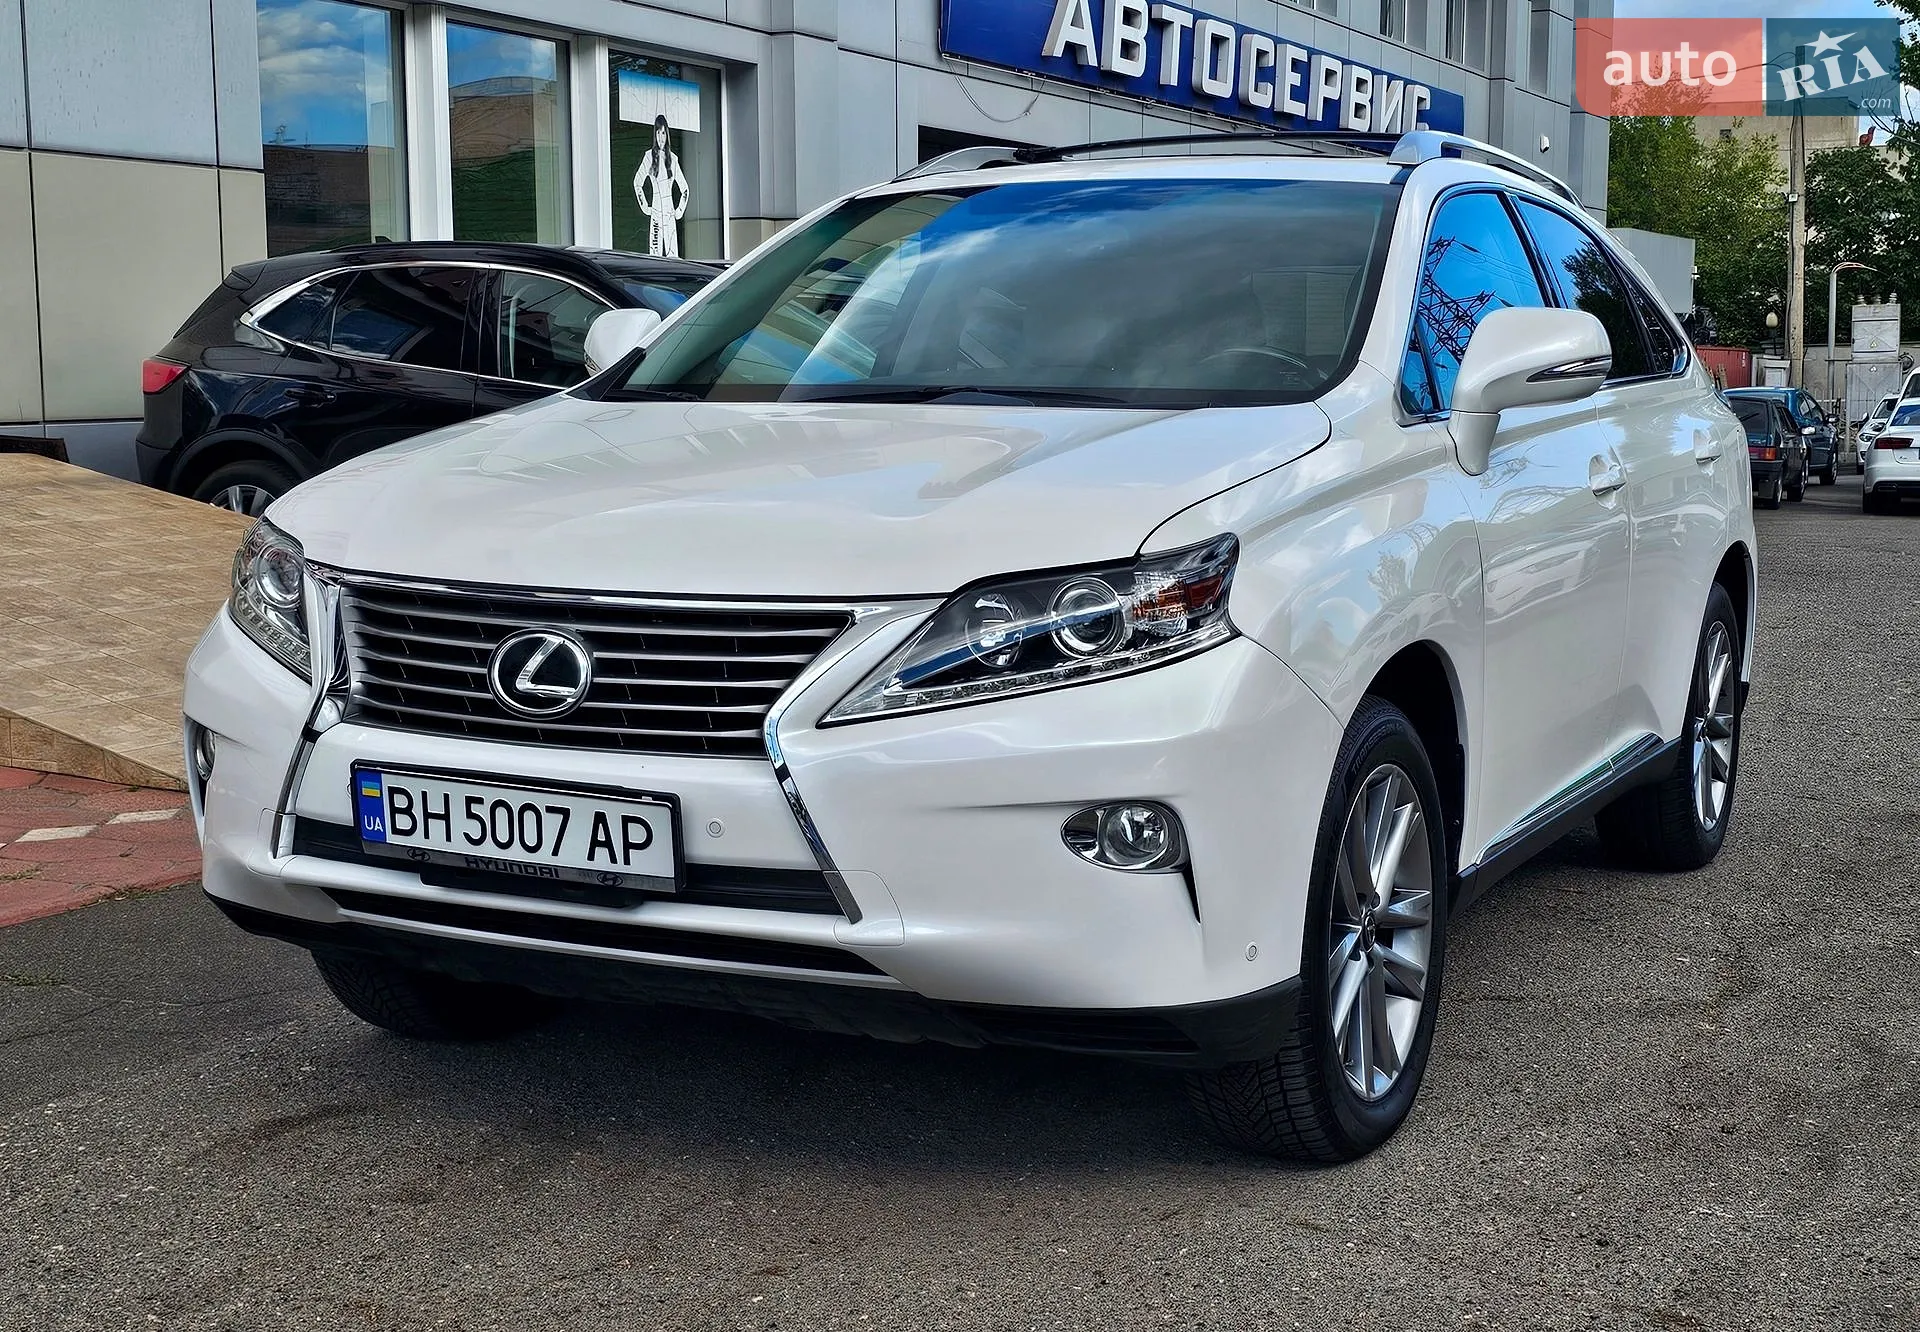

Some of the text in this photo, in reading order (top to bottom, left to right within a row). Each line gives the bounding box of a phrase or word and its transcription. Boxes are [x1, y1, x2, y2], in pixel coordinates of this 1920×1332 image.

[1041, 0, 1430, 131] АВТОСЕРВИС
[364, 814, 384, 833] UA
[387, 785, 655, 867] BH 5007 AP
[464, 856, 560, 879] HYUNDAI
